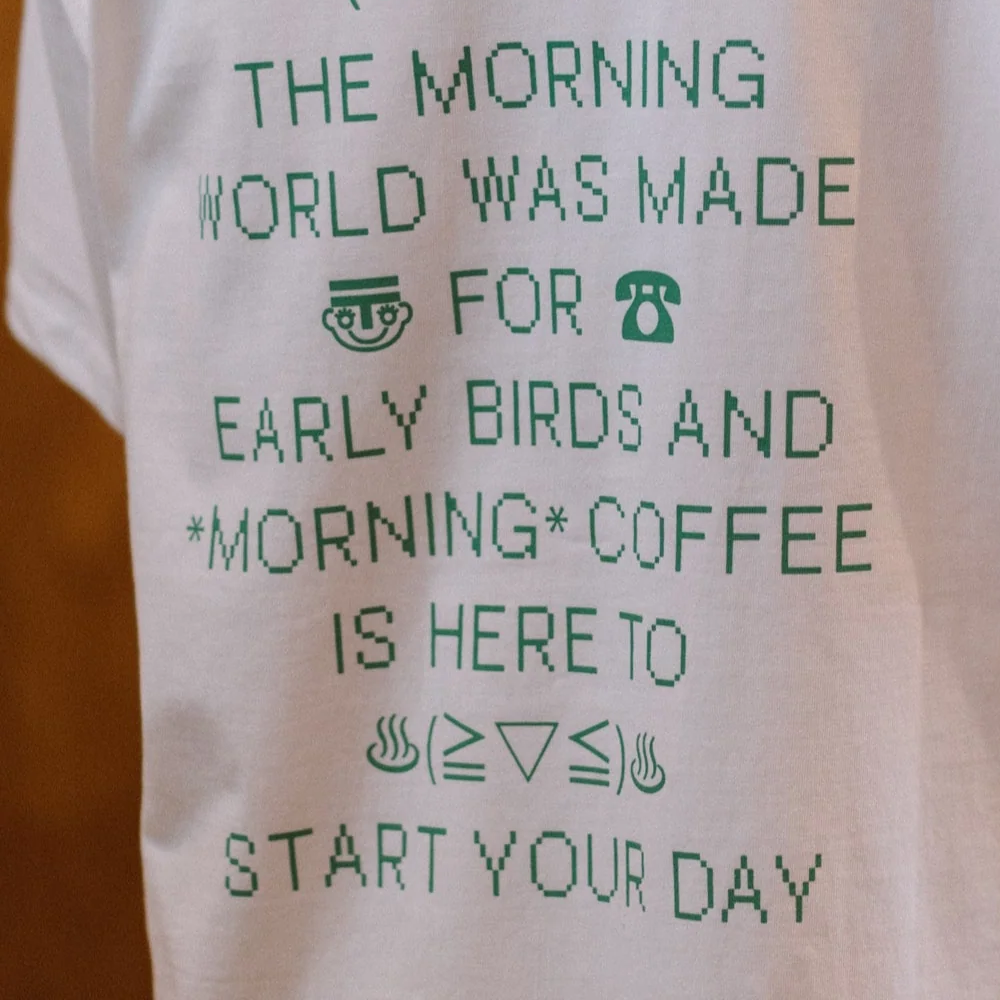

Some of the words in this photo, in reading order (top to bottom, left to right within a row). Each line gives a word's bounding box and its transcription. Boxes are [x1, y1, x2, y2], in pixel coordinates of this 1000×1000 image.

[234, 53, 379, 130] THE
[412, 39, 766, 118] MORNING
[199, 164, 427, 242] WORLD
[462, 154, 609, 224] WAS
[637, 155, 856, 227] MADE
[450, 267, 584, 337] FOR
[213, 384, 428, 464] EARLY
[466, 379, 643, 452] BIRDS
[668, 388, 834, 460] AND
[589, 495, 873, 576] COFFEE
[333, 604, 396, 675] IS
[429, 602, 599, 675] HERE
[618, 610, 688, 689] TO
[224, 823, 448, 899] START
[473, 830, 647, 914] YOUR
[672, 851, 823, 925] DAY
